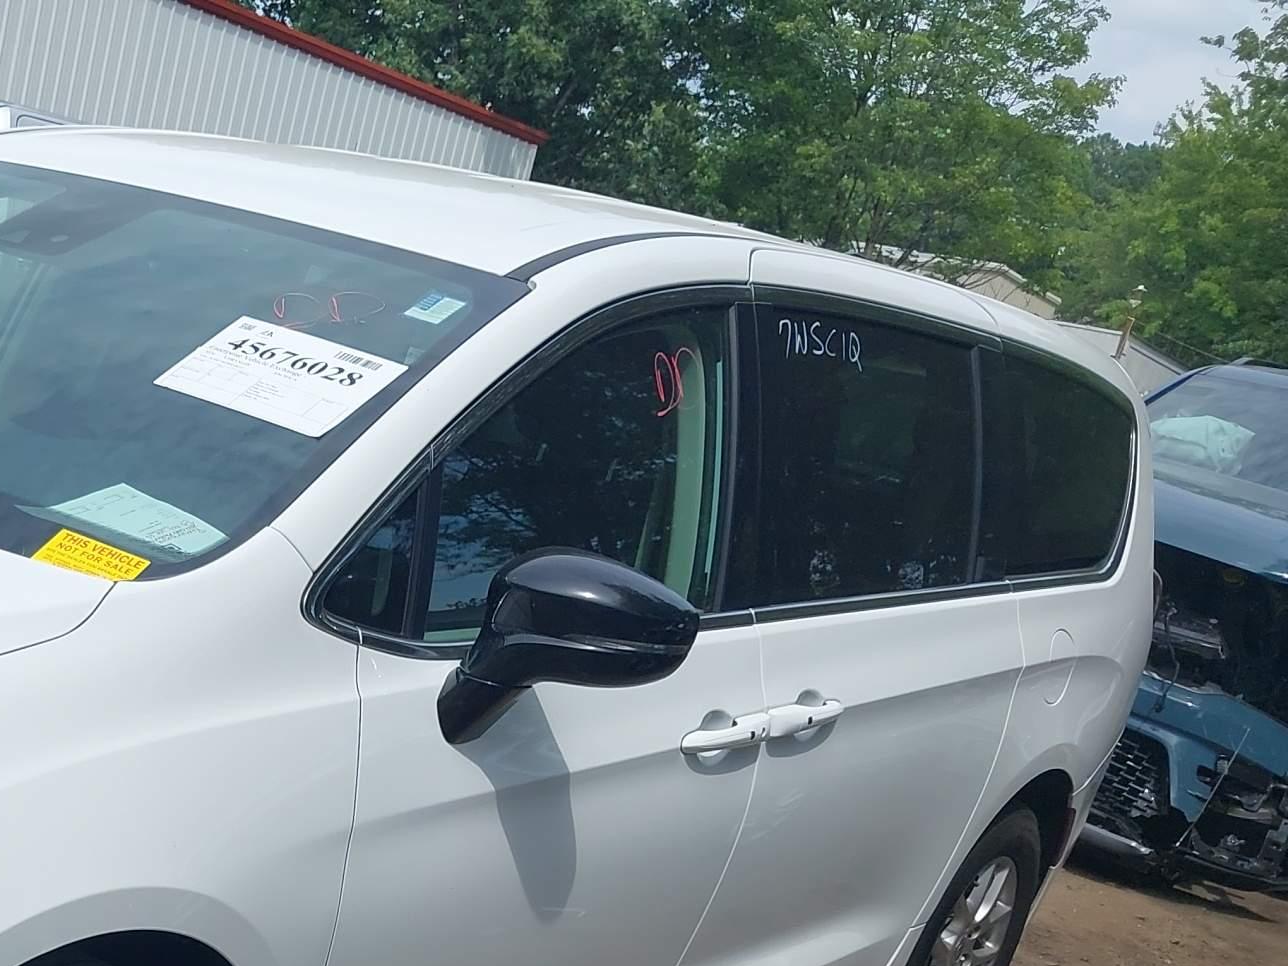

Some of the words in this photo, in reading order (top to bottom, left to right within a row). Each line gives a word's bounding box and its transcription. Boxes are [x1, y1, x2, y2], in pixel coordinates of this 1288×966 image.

[228, 338, 364, 387] 45676028
[56, 542, 78, 555] NOT
[80, 551, 103, 564] FOR
[103, 560, 134, 576] SALE
[62, 532, 90, 549] THIS
[92, 544, 146, 570] VEHICLE
